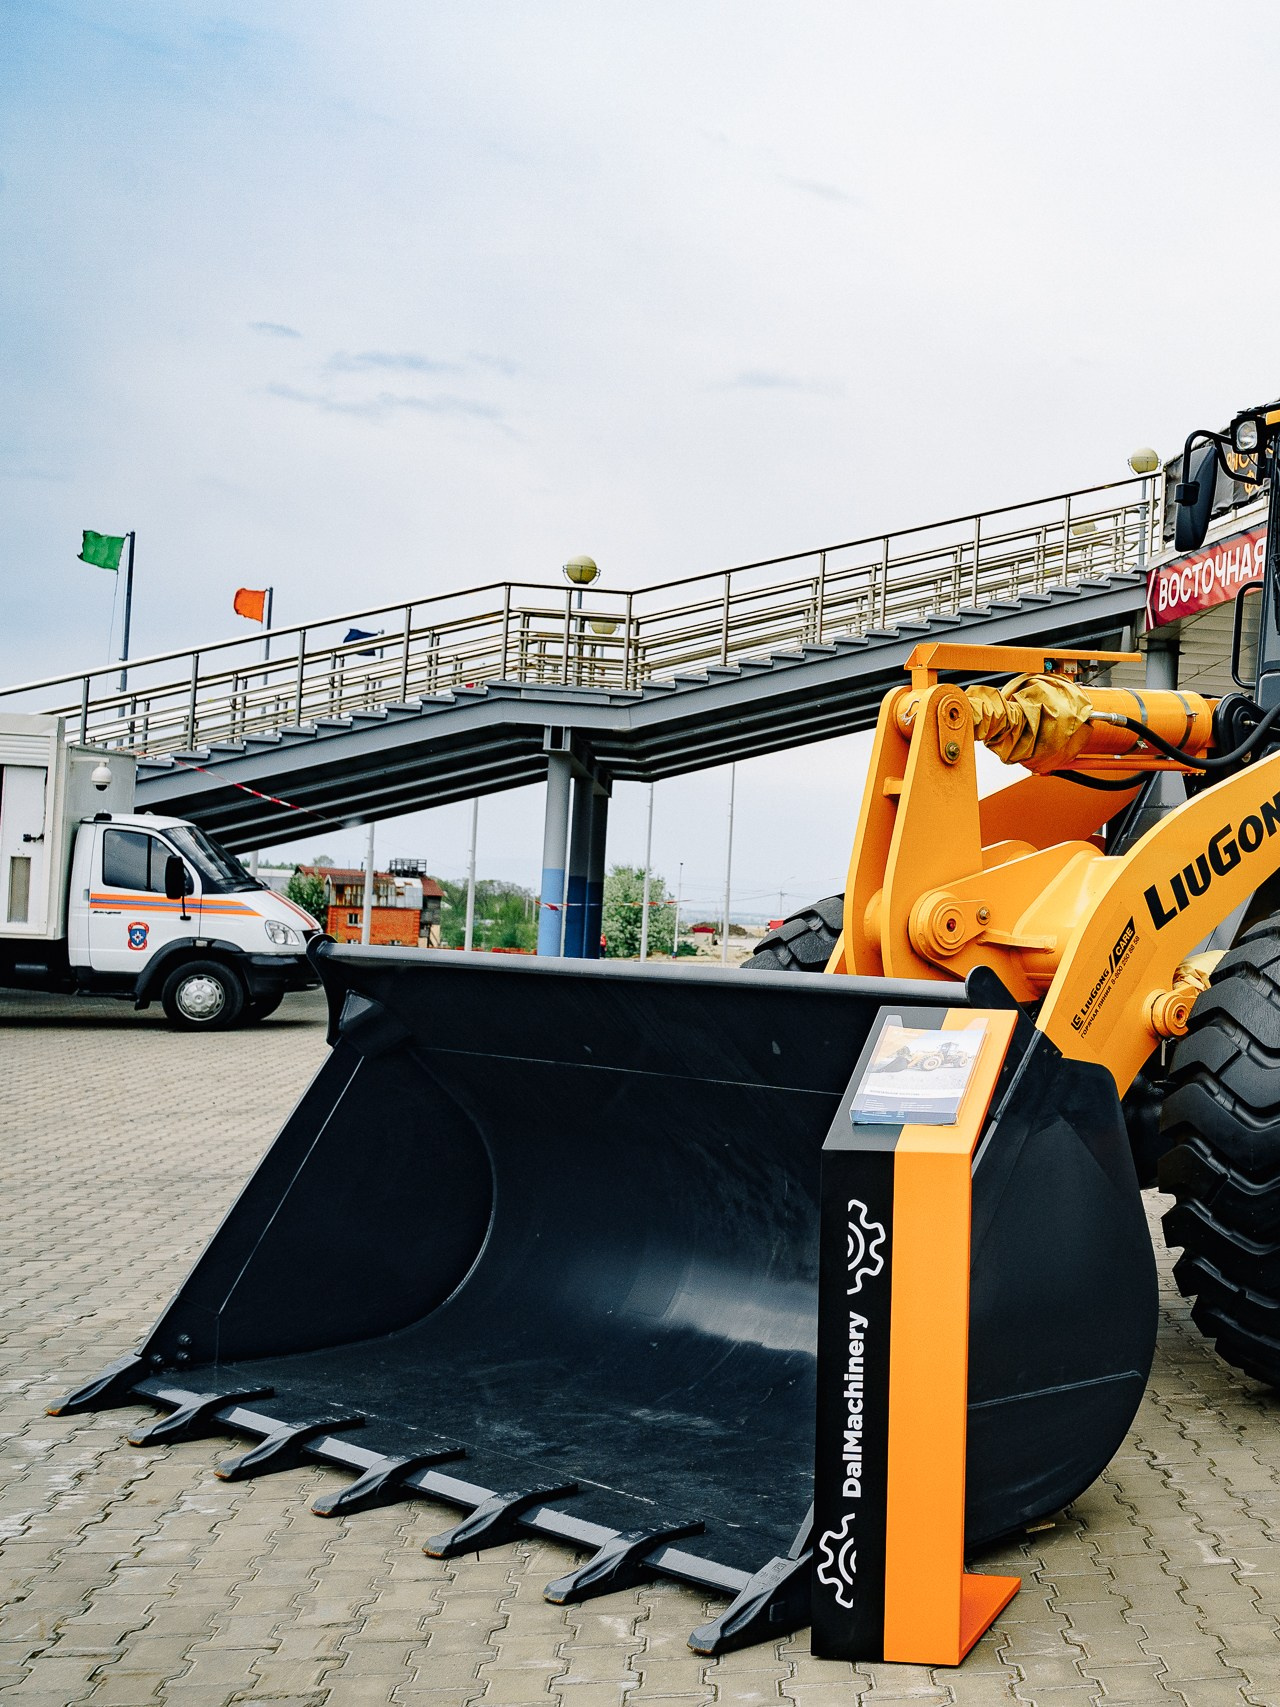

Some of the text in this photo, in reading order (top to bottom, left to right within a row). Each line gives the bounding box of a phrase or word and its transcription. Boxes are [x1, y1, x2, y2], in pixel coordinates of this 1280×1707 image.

[1158, 536, 1267, 612] ВОСТОЧНАЯ
[1115, 926, 1134, 956] CARE
[1081, 1010, 1100, 1039] ГОРЯЧАЯ
[1098, 985, 1113, 1009] ЛИНИЯ
[842, 1311, 869, 1499] DalMachinery
